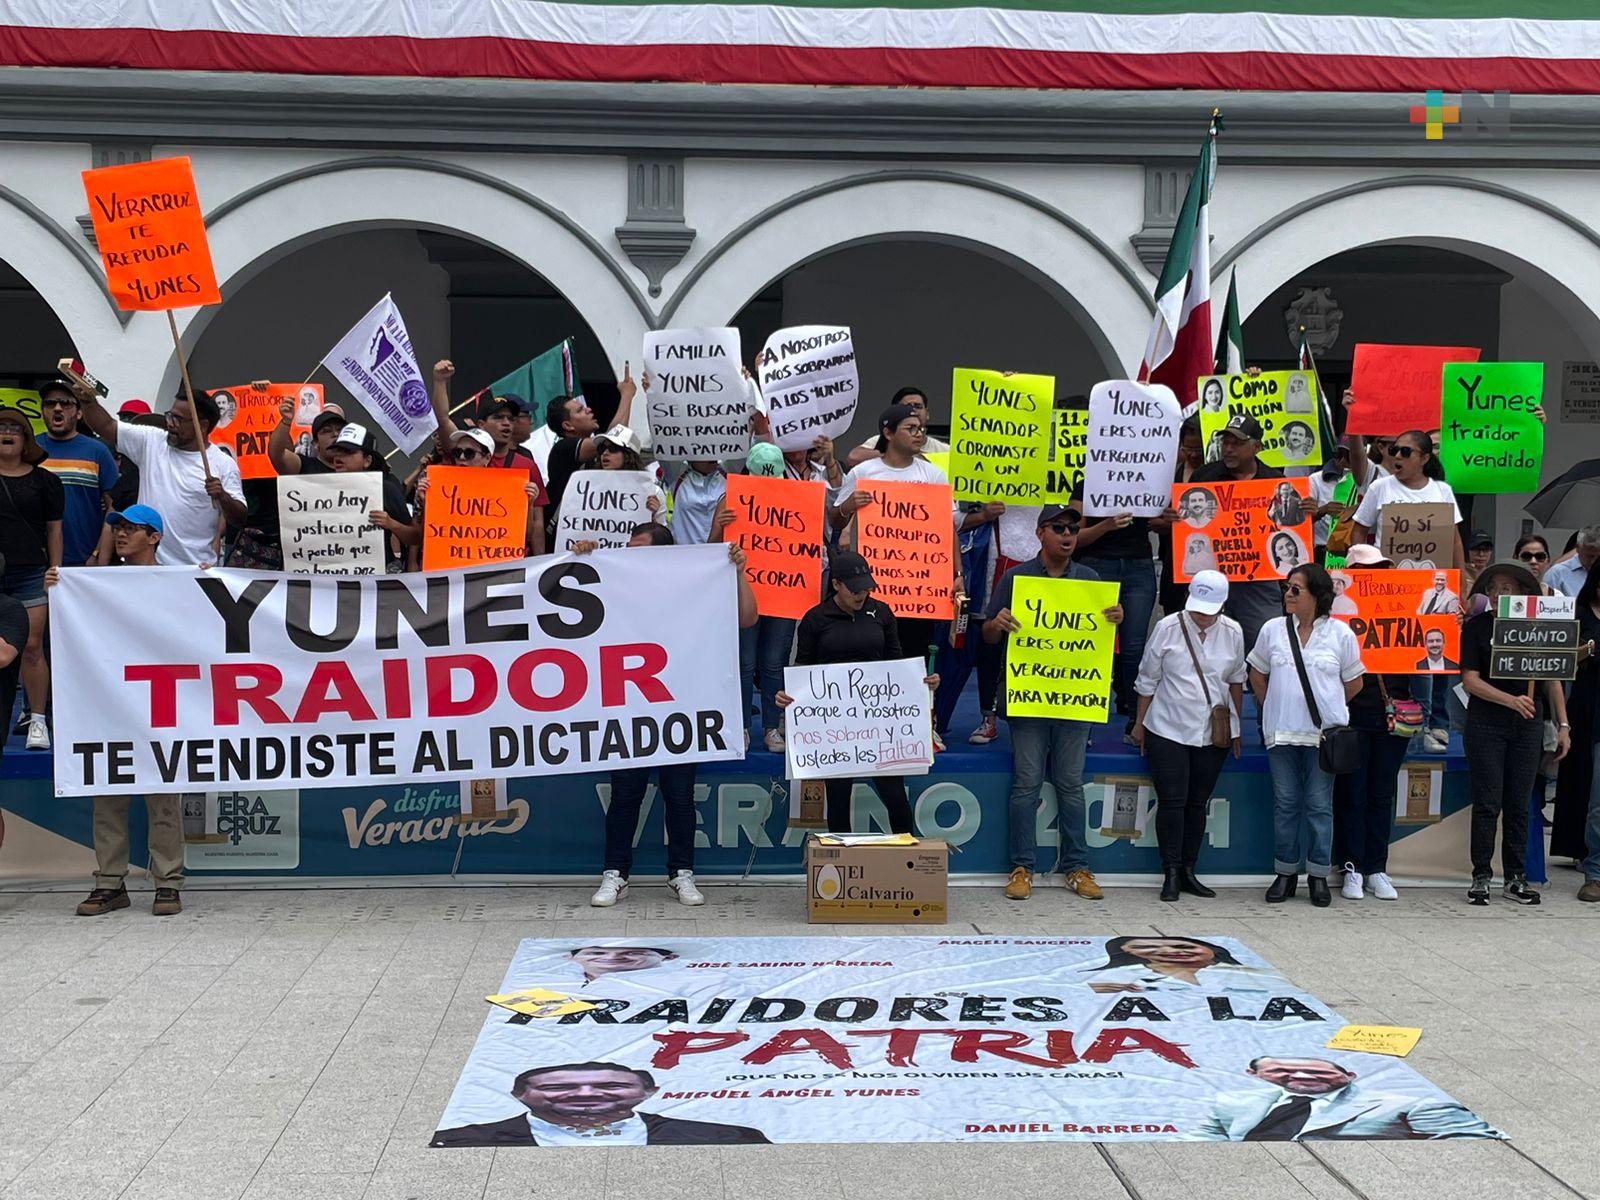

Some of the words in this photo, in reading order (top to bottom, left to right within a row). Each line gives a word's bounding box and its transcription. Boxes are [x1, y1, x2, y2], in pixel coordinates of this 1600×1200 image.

[95, 192, 195, 222] VERACRUZ
[124, 224, 154, 239] TE
[106, 242, 190, 267] REPUDIA
[127, 273, 201, 303] YUNES
[655, 344, 726, 360] FAMILIA
[763, 347, 779, 367] A
[781, 330, 850, 354] NOSOTROS
[764, 365, 791, 384] NOS
[793, 352, 854, 376] SOBRARON
[657, 373, 723, 394] YUNES
[1457, 374, 1538, 414] Yunes
[770, 396, 782, 411] A
[784, 387, 809, 405] LOS
[810, 379, 854, 398] YUNES
[970, 379, 1036, 412] YUNES
[1108, 390, 1164, 418] YUNES
[245, 414, 254, 426] A
[262, 413, 276, 424] LA
[653, 402, 681, 418] SE
[687, 402, 748, 418] BUSCAN
[775, 421, 798, 438] LES
[799, 400, 856, 431] FALTARON
[653, 424, 682, 436] POR
[960, 413, 1042, 438] SENADOR
[1100, 425, 1136, 438] ERES
[1141, 425, 1172, 438] UNA
[1448, 419, 1520, 441] traidor
[655, 444, 666, 455] A
[670, 444, 688, 456] LA
[693, 443, 743, 455] PATRIA
[956, 438, 1038, 459] CORONASTE
[1462, 447, 1535, 469] vendido
[974, 461, 984, 473] A
[995, 464, 1019, 475] UN
[577, 480, 640, 512] YUNES
[954, 476, 1041, 498] DICTADOR
[287, 490, 308, 512] Si
[315, 499, 333, 509] no
[338, 490, 369, 514] hay
[442, 485, 509, 518] YUNES
[873, 490, 930, 521] YUNES
[1090, 493, 1166, 508] VERACRUZ
[739, 495, 806, 533] YUNES
[1234, 512, 1250, 526] SU
[293, 520, 354, 542] justicia
[428, 523, 510, 539] SENADOR
[562, 516, 637, 535] SENADOR
[865, 523, 941, 544] CORRUPTO
[1220, 527, 1251, 537] VOTO
[1259, 525, 1267, 534] Y
[292, 548, 304, 559] el
[308, 543, 344, 561] pueblo
[350, 545, 372, 558] que
[450, 545, 471, 559] DEL
[477, 545, 527, 559] PUEBLO
[739, 533, 783, 552] ERES
[788, 543, 821, 558] UNA
[863, 545, 906, 561] DEJAS
[910, 552, 919, 561] A
[924, 552, 949, 564] LOS
[1213, 538, 1253, 552] PUEBLO
[1386, 537, 1437, 560] tengo
[1217, 551, 1260, 563] DEJARON
[745, 567, 806, 588] SCORIA
[906, 569, 930, 579] SIN
[873, 584, 911, 596] ATRIA
[915, 586, 923, 596] Y
[927, 586, 948, 598] SIN
[194, 561, 606, 654] YUNES
[1025, 599, 1098, 632] YUNES
[1375, 603, 1383, 613] A
[1389, 602, 1406, 612] LA
[1016, 636, 1054, 650] ERES
[1059, 639, 1096, 652] UNA
[1349, 617, 1425, 650] PATRIA
[1503, 626, 1568, 644] ¡CUÁNTO
[1498, 657, 1514, 671] ME
[1521, 658, 1567, 673] DUELES!
[123, 641, 677, 729] TRAIDOR
[809, 669, 842, 701] Un
[1008, 689, 1042, 704] PARA
[793, 705, 841, 726] porque
[846, 706, 858, 718] a
[864, 703, 921, 719] nosotros
[793, 730, 822, 745] nos
[826, 725, 880, 744] sobran
[885, 727, 894, 744] y
[901, 723, 915, 736] a
[72, 740, 136, 785] TE
[149, 731, 398, 783] VENDISTE
[411, 728, 475, 773] AL
[490, 709, 728, 769] DICTADOR
[796, 748, 851, 769] ustedes
[855, 746, 877, 764] les
[217, 795, 269, 816] ERA
[394, 788, 461, 816] disfru
[217, 816, 281, 835] CRUZ
[342, 799, 530, 849] Veracruz
[848, 866, 864, 879] El
[847, 886, 914, 901] Calvario
[686, 960, 731, 969] JOSÉ
[737, 960, 806, 968] SABINO
[1102, 996, 1171, 1022] A
[1206, 996, 1328, 1022] LA
[652, 1027, 1200, 1070] PATRIA
[853, 1071, 898, 1079] NOS
[759, 1088, 835, 1098] ÁNGEL
[844, 1088, 920, 1097] YUNES
[964, 1123, 1054, 1134] DANIEL
[1062, 1123, 1179, 1134] BARREDA
